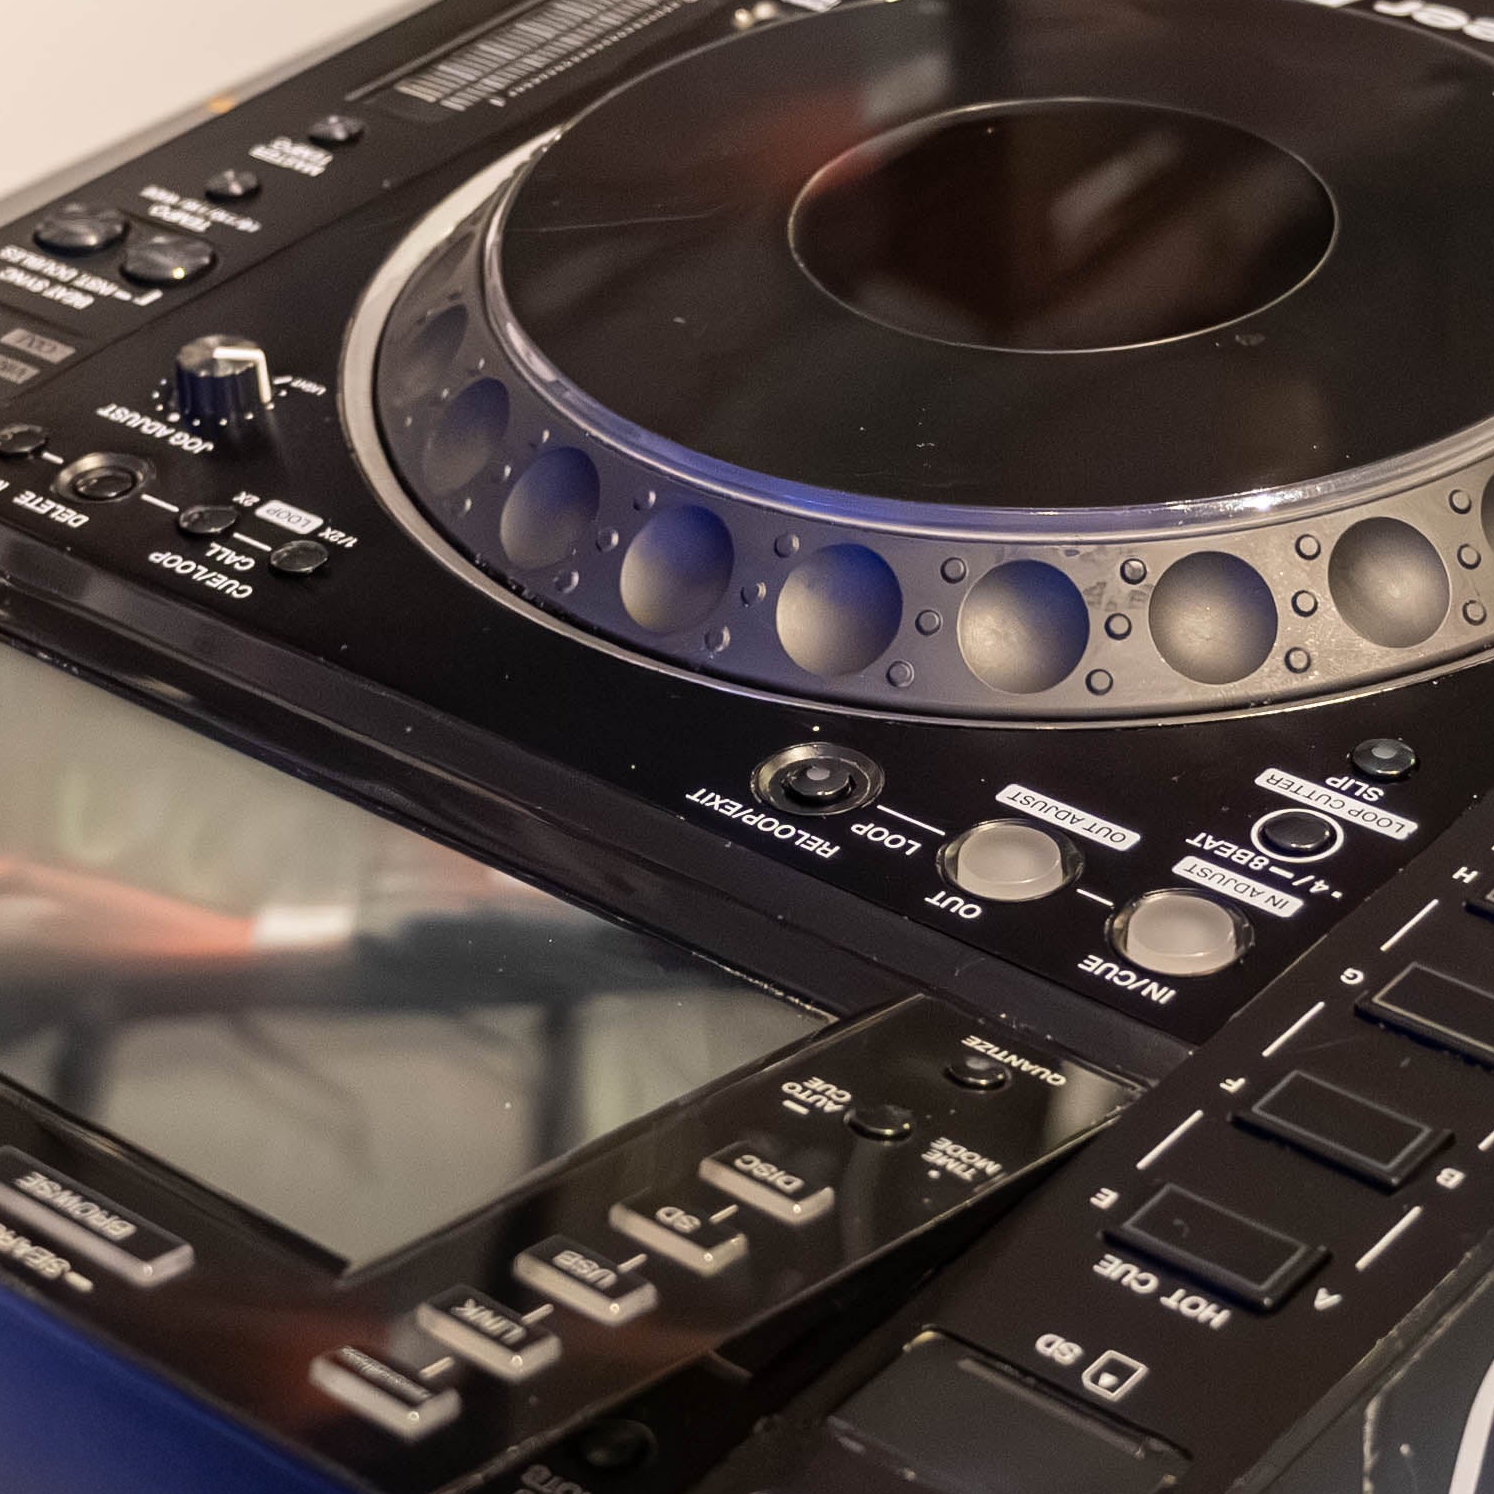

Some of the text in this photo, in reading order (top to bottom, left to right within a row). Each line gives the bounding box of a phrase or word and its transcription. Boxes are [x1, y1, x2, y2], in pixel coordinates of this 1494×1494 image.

[96, 404, 214, 454] JOG ADJUST
[11, 490, 90, 529] DELETE
[233, 491, 261, 507] 2X
[264, 505, 310, 531] LOOP
[318, 526, 358, 549] 1/2X
[205, 541, 256, 572] CALL
[148, 551, 253, 599] CUE/LOOP
[1265, 772, 1406, 835] LOOP CUTTER
[1324, 774, 1385, 803] SLIP
[685, 787, 841, 859] RELOOP/EXIT
[1007, 791, 1127, 844] OUT ADJUST
[850, 822, 922, 857] LOOP
[1181, 861, 1290, 910] IN ADJUST
[1451, 866, 1478, 885] H
[923, 891, 983, 920] OUT
[1077, 954, 1178, 1006] IN/CUE
[1339, 967, 1365, 986] G
[960, 1035, 1066, 1086] QUANTIZE
[781, 1081, 845, 1114] AUTO
[802, 1076, 852, 1105] CUE
[1219, 1077, 1246, 1094] F
[921, 1148, 978, 1182] TIME
[930, 1137, 1003, 1176] MODE
[734, 1154, 805, 1194] DISC
[1435, 1167, 1466, 1190] B
[13, 1171, 138, 1242] BROWSE
[1089, 1187, 1119, 1209] E
[655, 1205, 703, 1233] SD
[552, 1249, 619, 1291] USB
[1092, 1253, 1232, 1331] HOT CUE
[1313, 1287, 1343, 1311] A
[450, 1299, 527, 1343] LINK
[1034, 1332, 1084, 1366] SD
